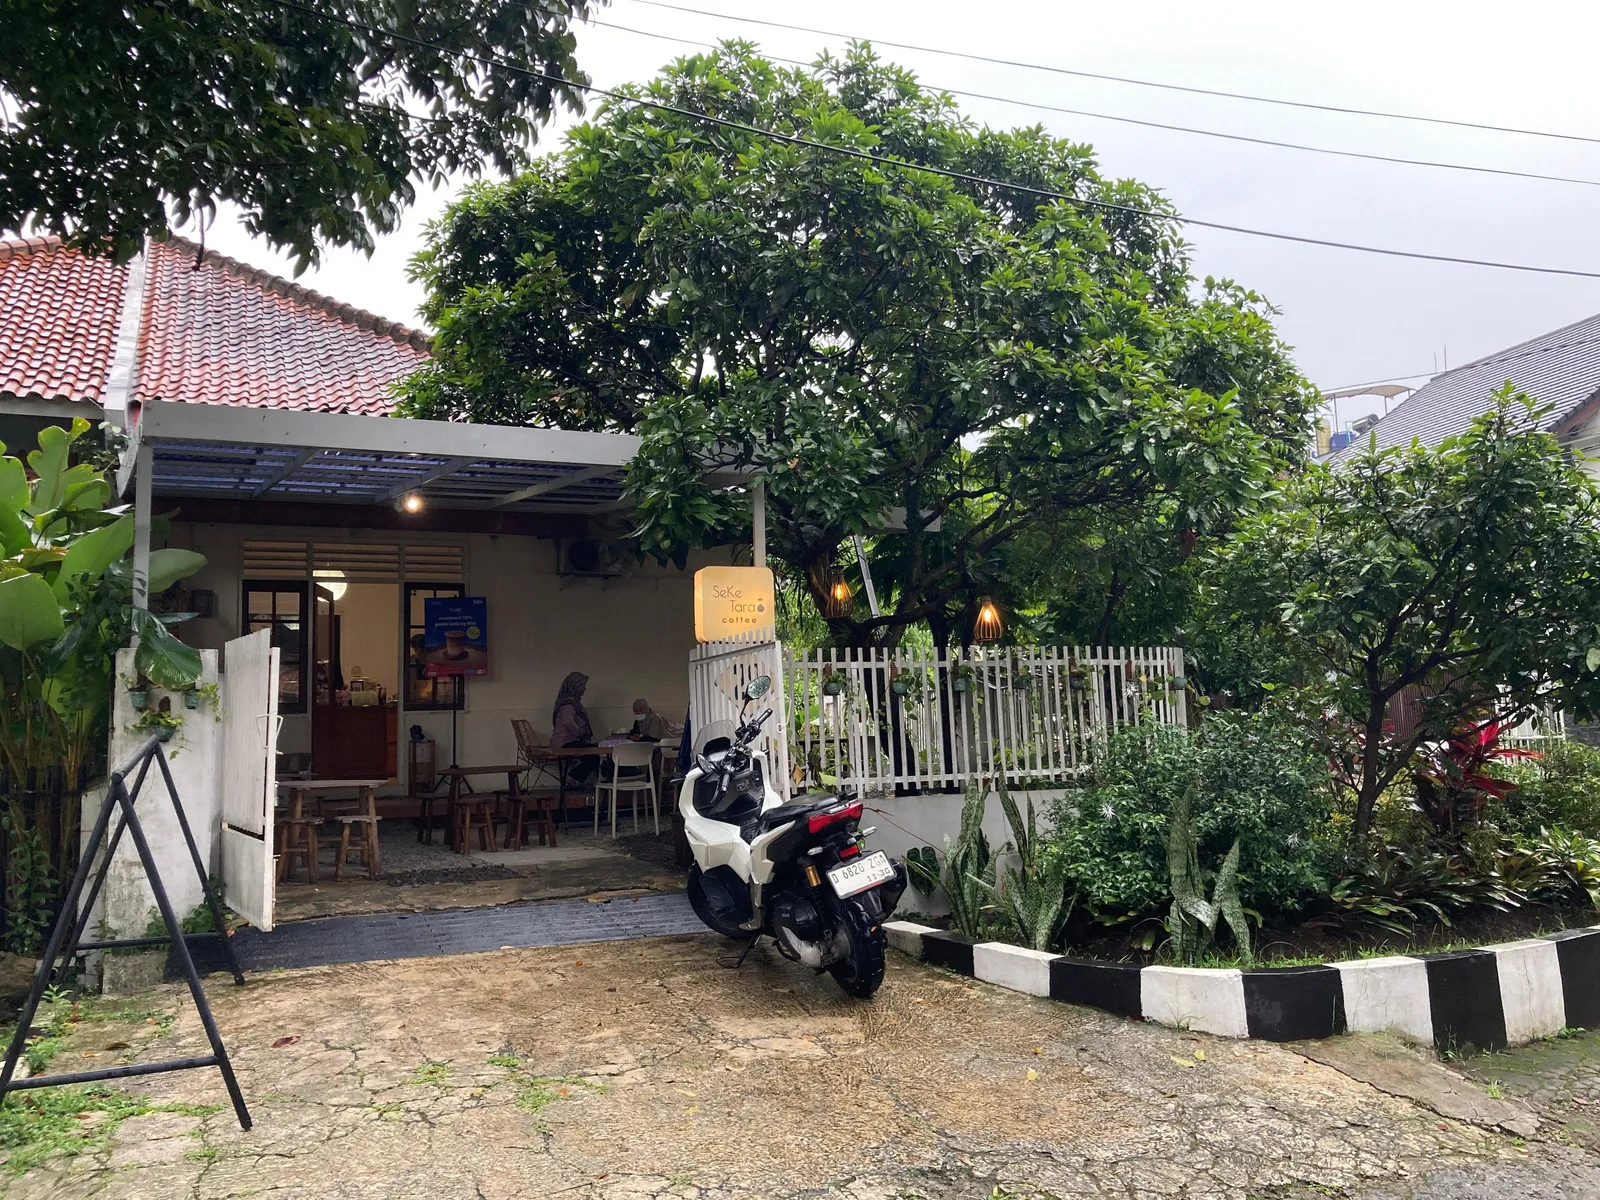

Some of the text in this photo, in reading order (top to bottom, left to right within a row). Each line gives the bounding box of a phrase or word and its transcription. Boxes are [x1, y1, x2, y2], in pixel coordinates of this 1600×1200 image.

[712, 585, 742, 598] SeKe
[729, 600, 756, 612] Tara
[831, 873, 840, 884] D
